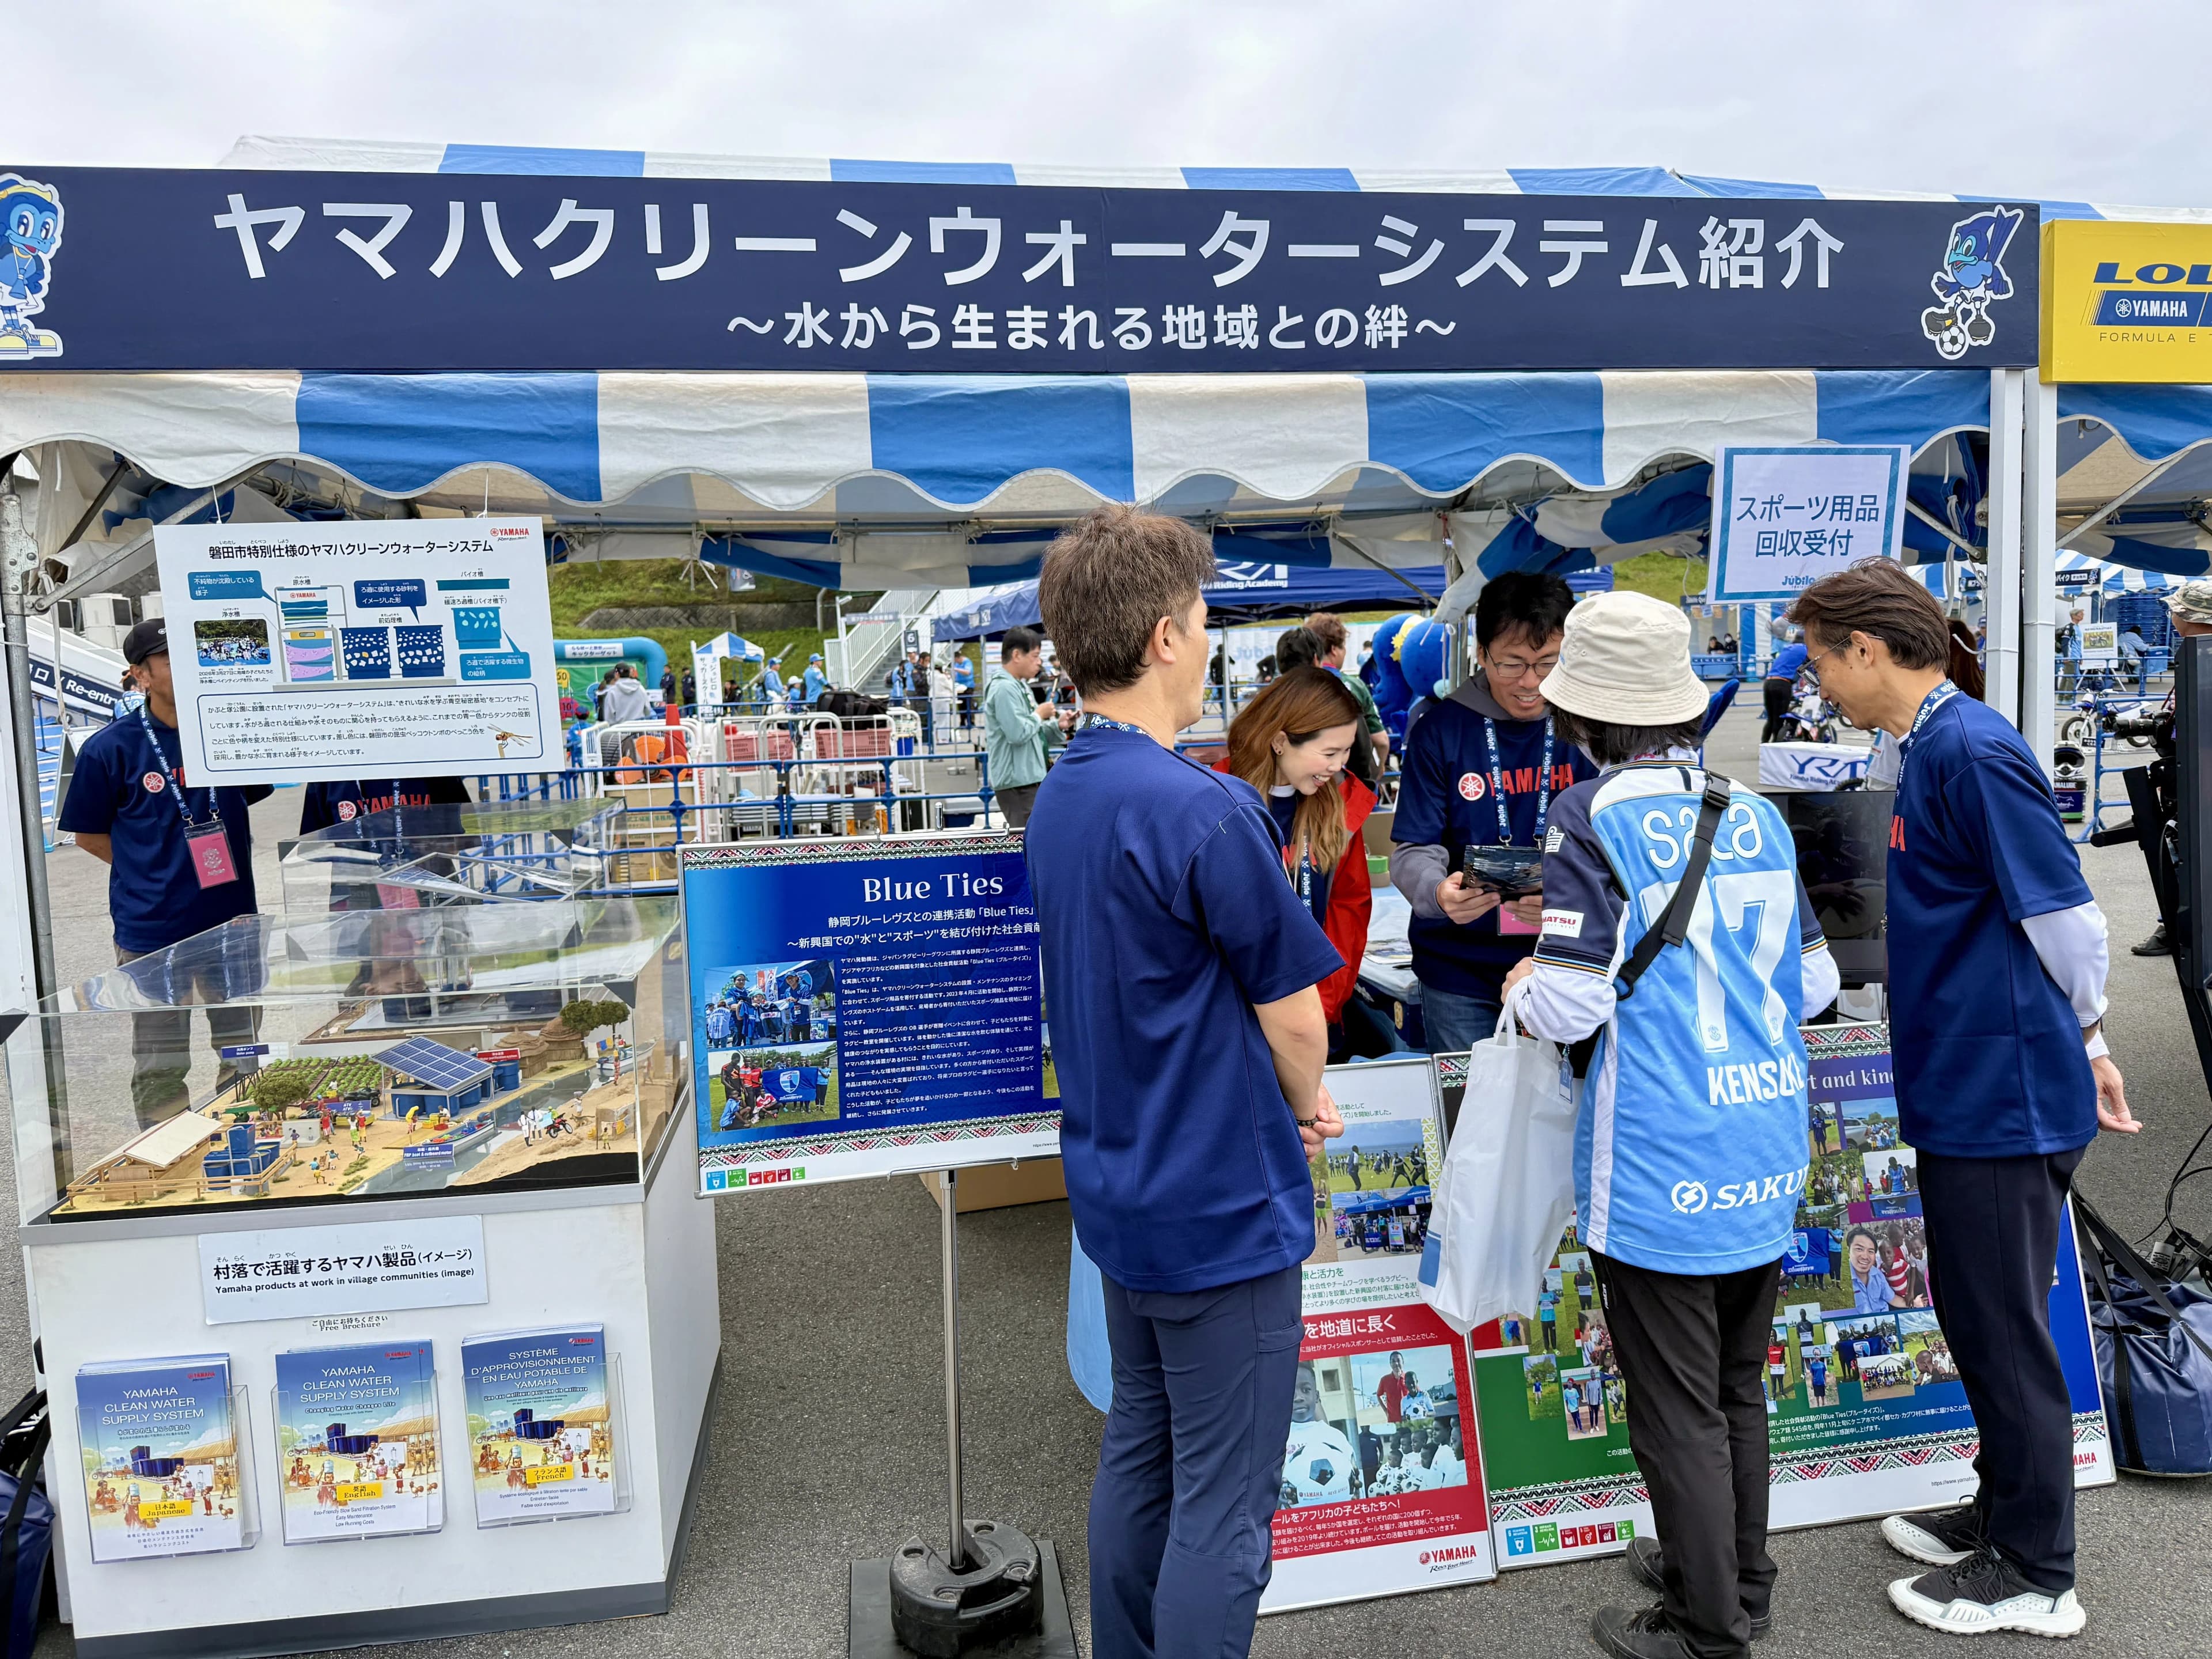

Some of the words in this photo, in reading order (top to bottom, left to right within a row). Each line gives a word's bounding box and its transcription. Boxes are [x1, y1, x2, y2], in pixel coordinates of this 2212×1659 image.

[214, 193, 1843, 289] ヤマハクリーンウォーターシステム紹介
[2133, 300, 2188, 317] YAMAHA
[2100, 332, 2175, 342] FORMULA
[2189, 334, 2196, 342] E
[1736, 494, 1880, 522] スポーツ用品
[499, 528, 529, 536] YAMAHA
[209, 540, 494, 559] 磐田市特別仕様のヤマハクリーンウォーターシステム
[1755, 529, 1853, 558] 回収受付
[1214, 581, 1244, 590] Riding
[1245, 579, 1288, 588] Academy
[908, 633, 915, 643] 6
[862, 878, 931, 902] Blue
[940, 873, 1003, 897] Ties
[1823, 1071, 1856, 1089] and
[215, 1285, 252, 1294] Yamaha
[255, 1281, 296, 1293] products
[311, 1277, 334, 1286] work
[336, 1276, 345, 1285] in
[348, 1274, 378, 1285] village
[381, 1270, 439, 1282] communities
[441, 1268, 474, 1278] (image)
[342, 1322, 381, 1330] Brochure
[1305, 1314, 1396, 1339] を地道に長く
[509, 1346, 559, 1360] SYSTÈME
[322, 1365, 376, 1377] YAMAHA
[471, 1355, 596, 1376] D'APPROVISIONNEMENT
[483, 1374, 497, 1383] EN
[500, 1372, 521, 1381] EAU
[525, 1368, 571, 1378] POTABLE
[574, 1366, 588, 1374] DE
[303, 1379, 345, 1391] CLEAN
[349, 1375, 392, 1387] WATER
[514, 1378, 559, 1389] YAMAHA
[123, 1387, 178, 1399] YAMAHA
[300, 1391, 348, 1403] SUPPLY
[350, 1387, 400, 1399] SYSTEM
[105, 1400, 147, 1413] CLEAN
[151, 1397, 196, 1410] WATER
[102, 1412, 150, 1426] SUPPLY
[153, 1408, 204, 1421] SYSTEM
[534, 1466, 567, 1476] フランス語
[537, 1472, 564, 1480] French
[344, 1490, 376, 1498] English
[1431, 1545, 1476, 1562] YAMAHA
[1430, 1563, 1447, 1573] Revs
